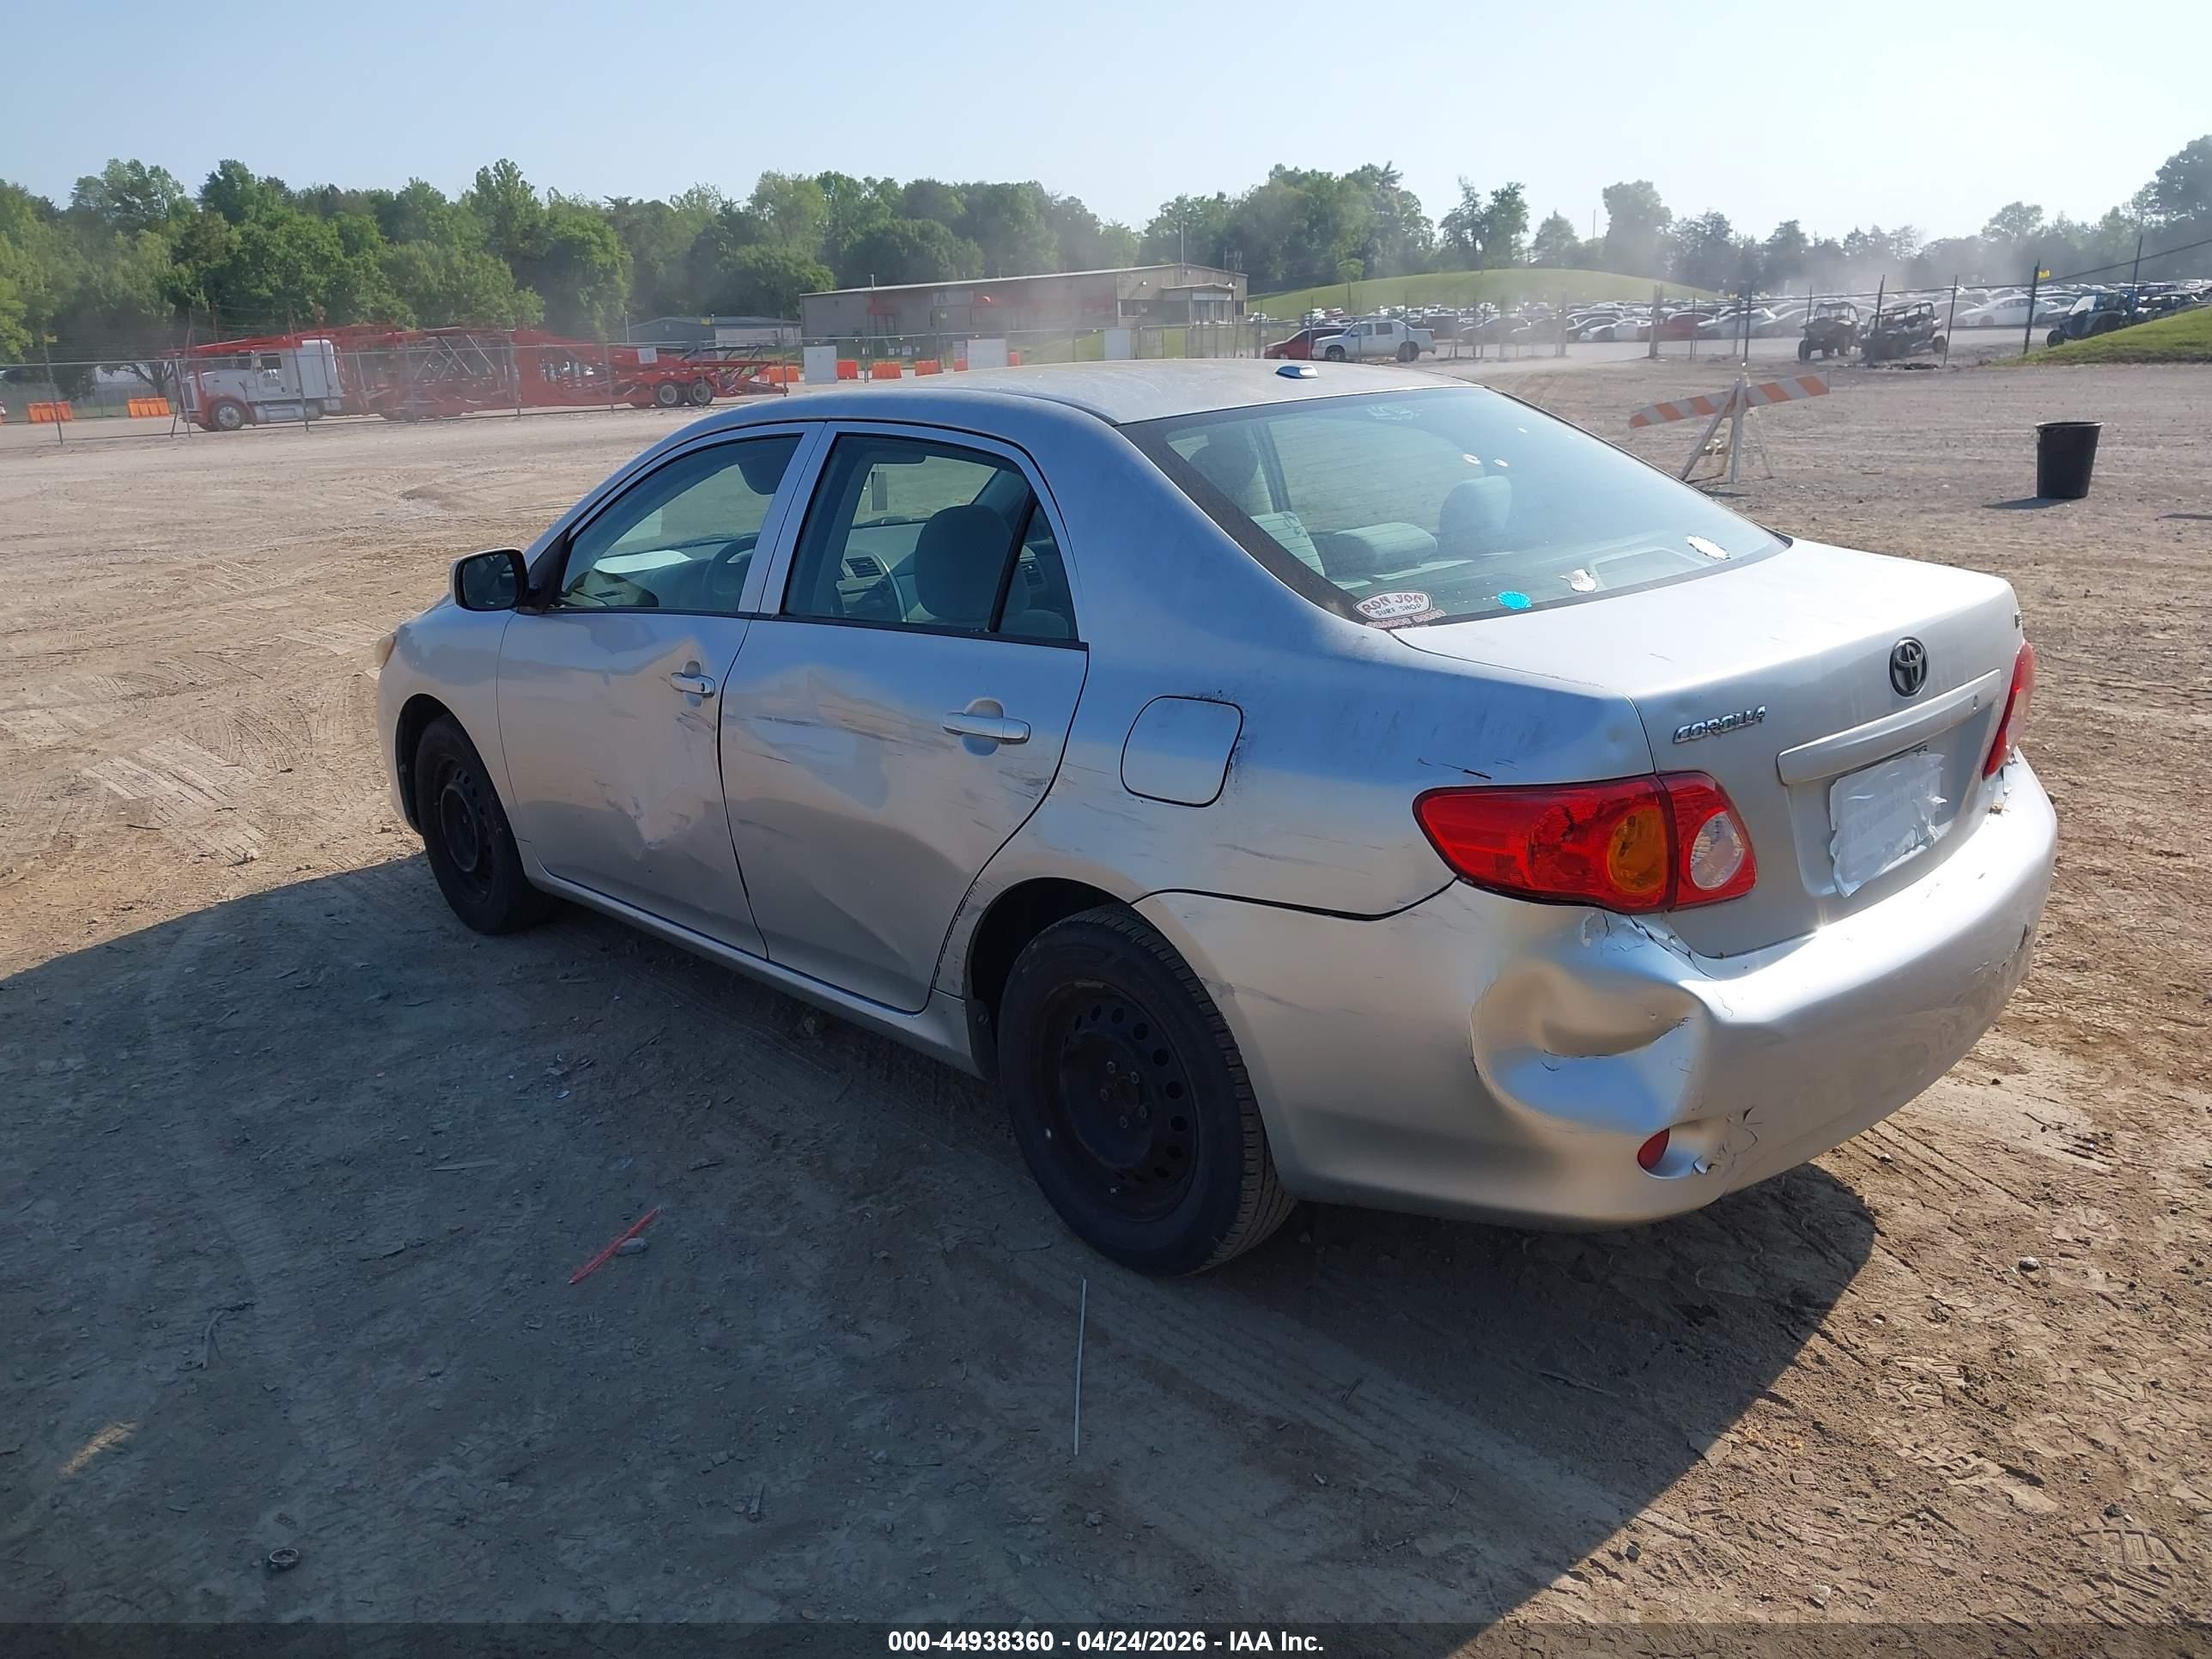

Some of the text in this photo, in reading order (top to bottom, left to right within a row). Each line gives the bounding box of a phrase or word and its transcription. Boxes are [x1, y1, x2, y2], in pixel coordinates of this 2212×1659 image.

[1362, 593, 1424, 614] RON JON
[1375, 603, 1422, 617] SURF SHOP
[1673, 705, 1766, 744] COROLLA
